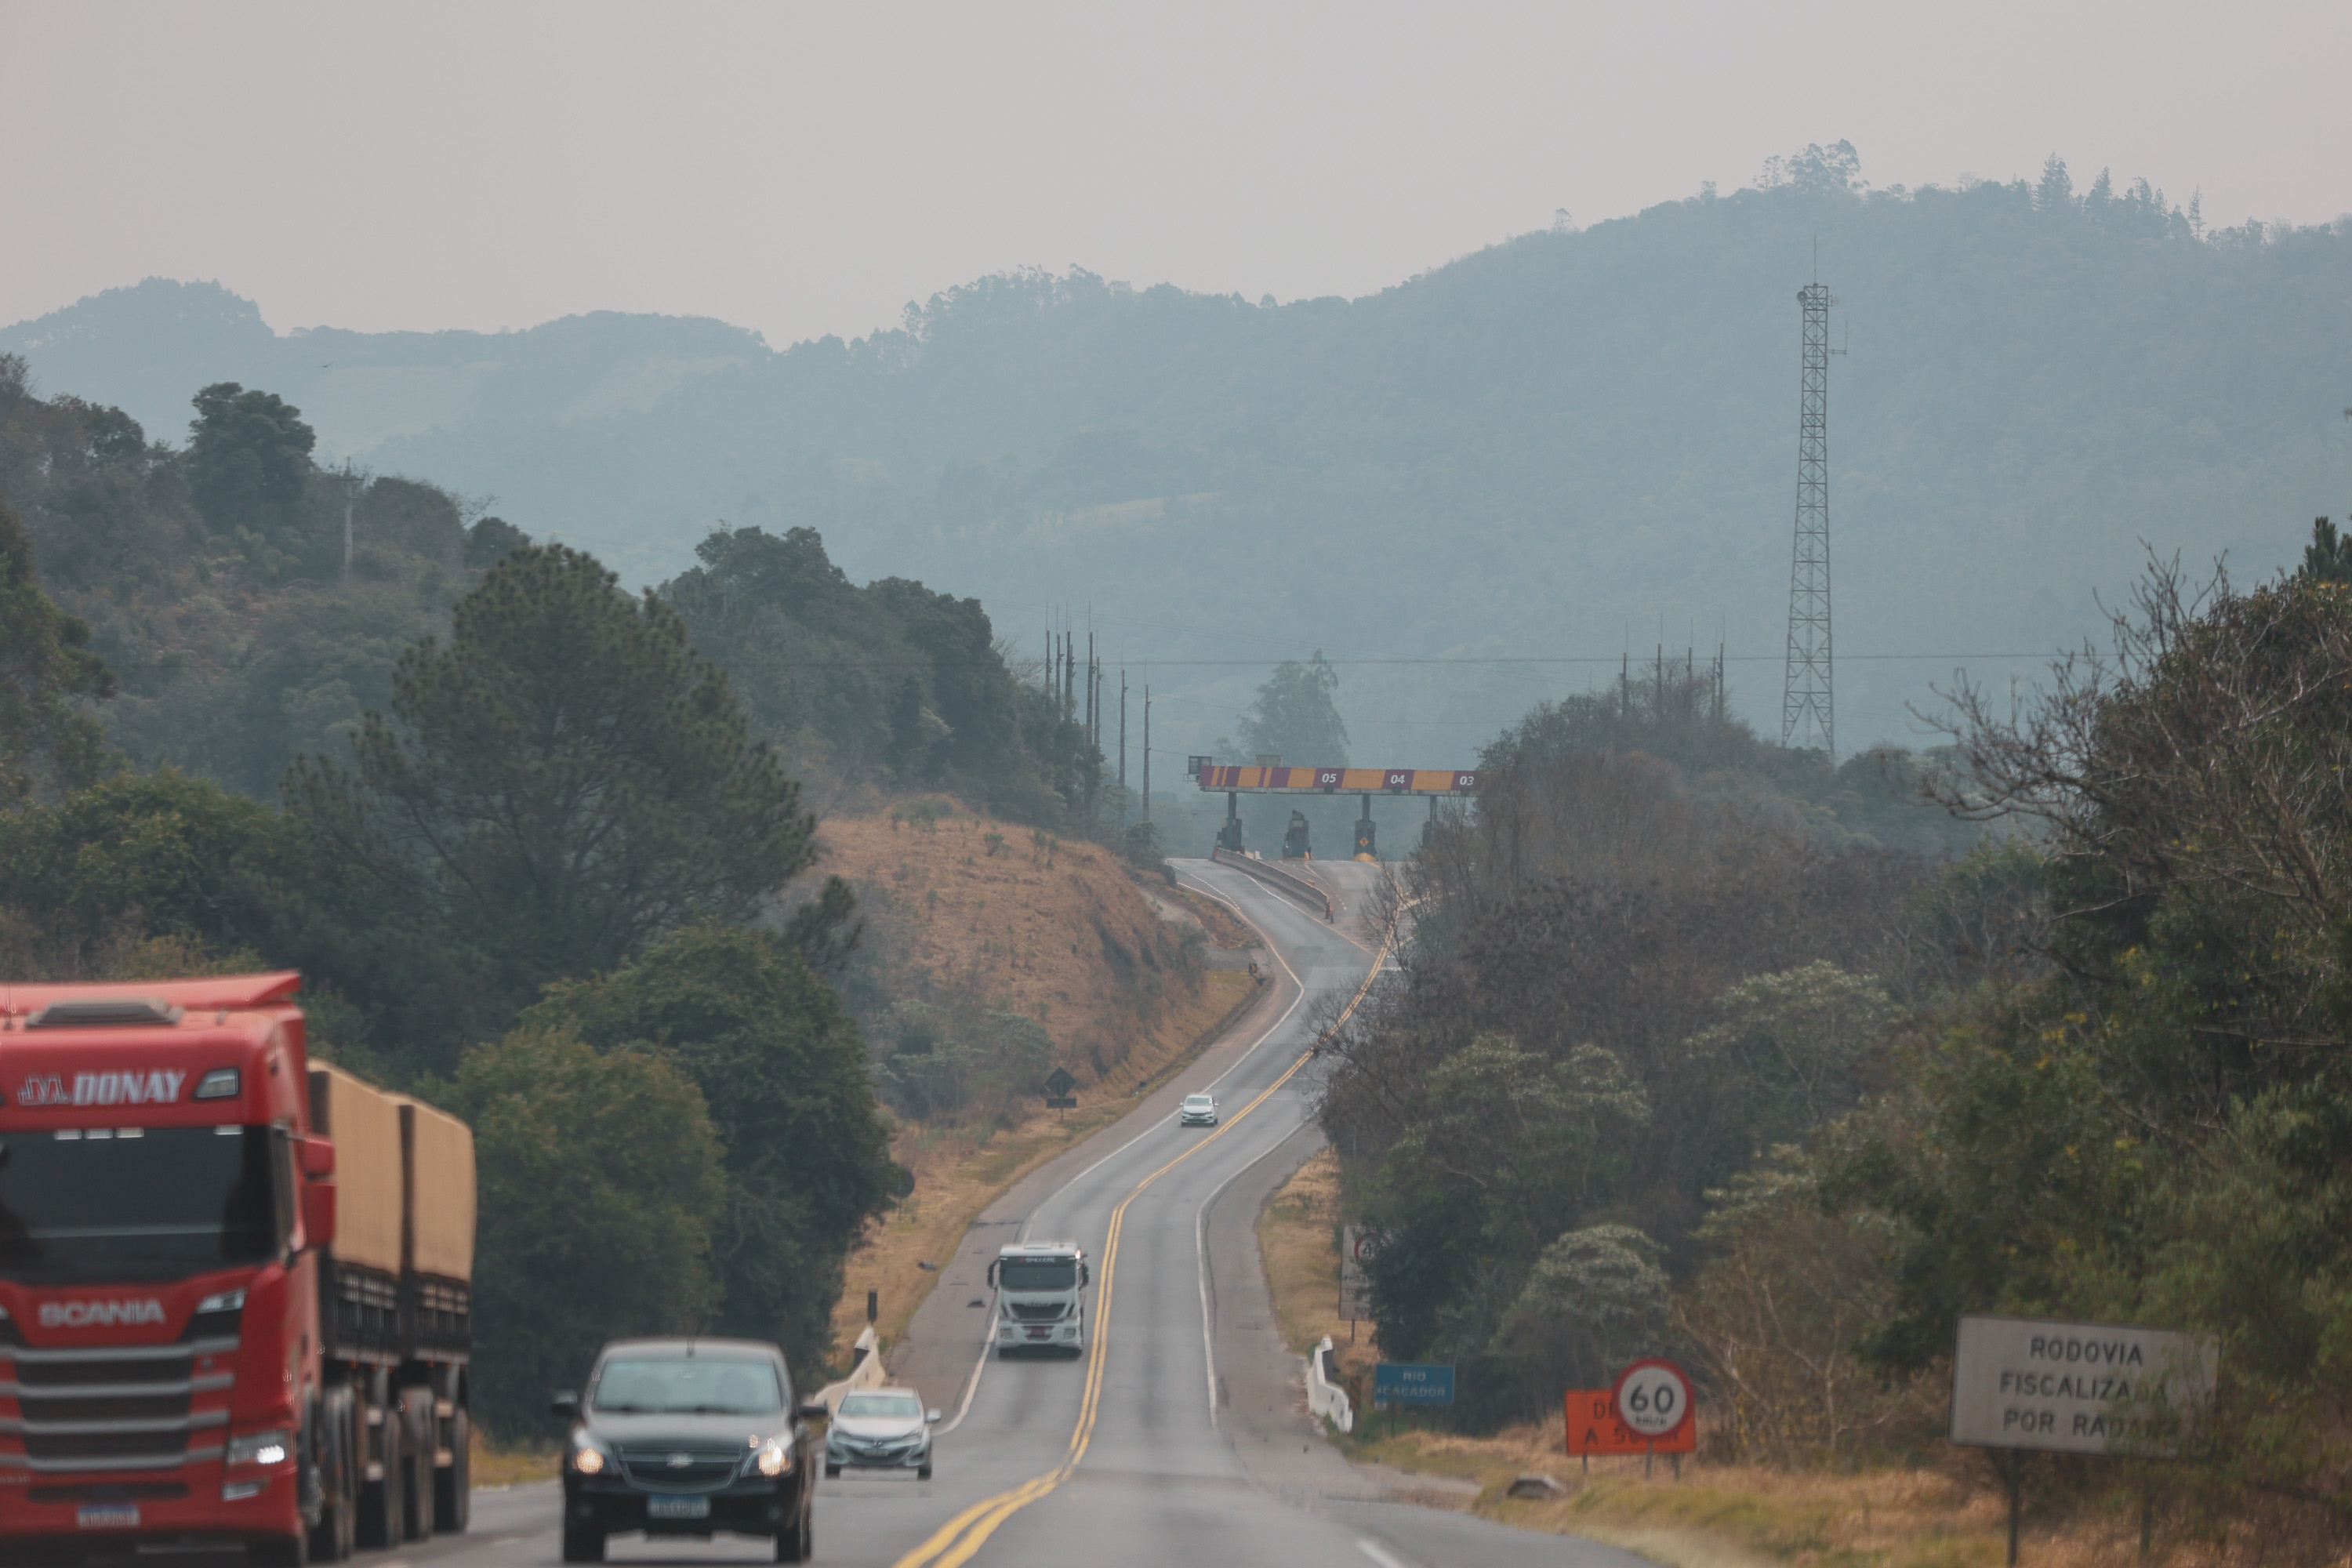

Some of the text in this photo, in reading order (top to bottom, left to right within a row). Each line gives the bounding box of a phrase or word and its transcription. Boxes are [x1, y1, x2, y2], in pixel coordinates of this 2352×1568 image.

[1321, 773, 1337, 783] 05
[1390, 775, 1406, 784] 04
[1459, 775, 1475, 786] 03
[72, 1069, 187, 1106] DONAY
[38, 1299, 166, 1327] SCANIA
[2029, 1335, 2143, 1367] RODOVIA
[1403, 1369, 1426, 1382] RIO
[1999, 1370, 2169, 1406] FISCALIZADA
[1630, 1382, 1675, 1414] 60
[2003, 1404, 2056, 1435] POR
[1584, 1427, 1599, 1446] A
